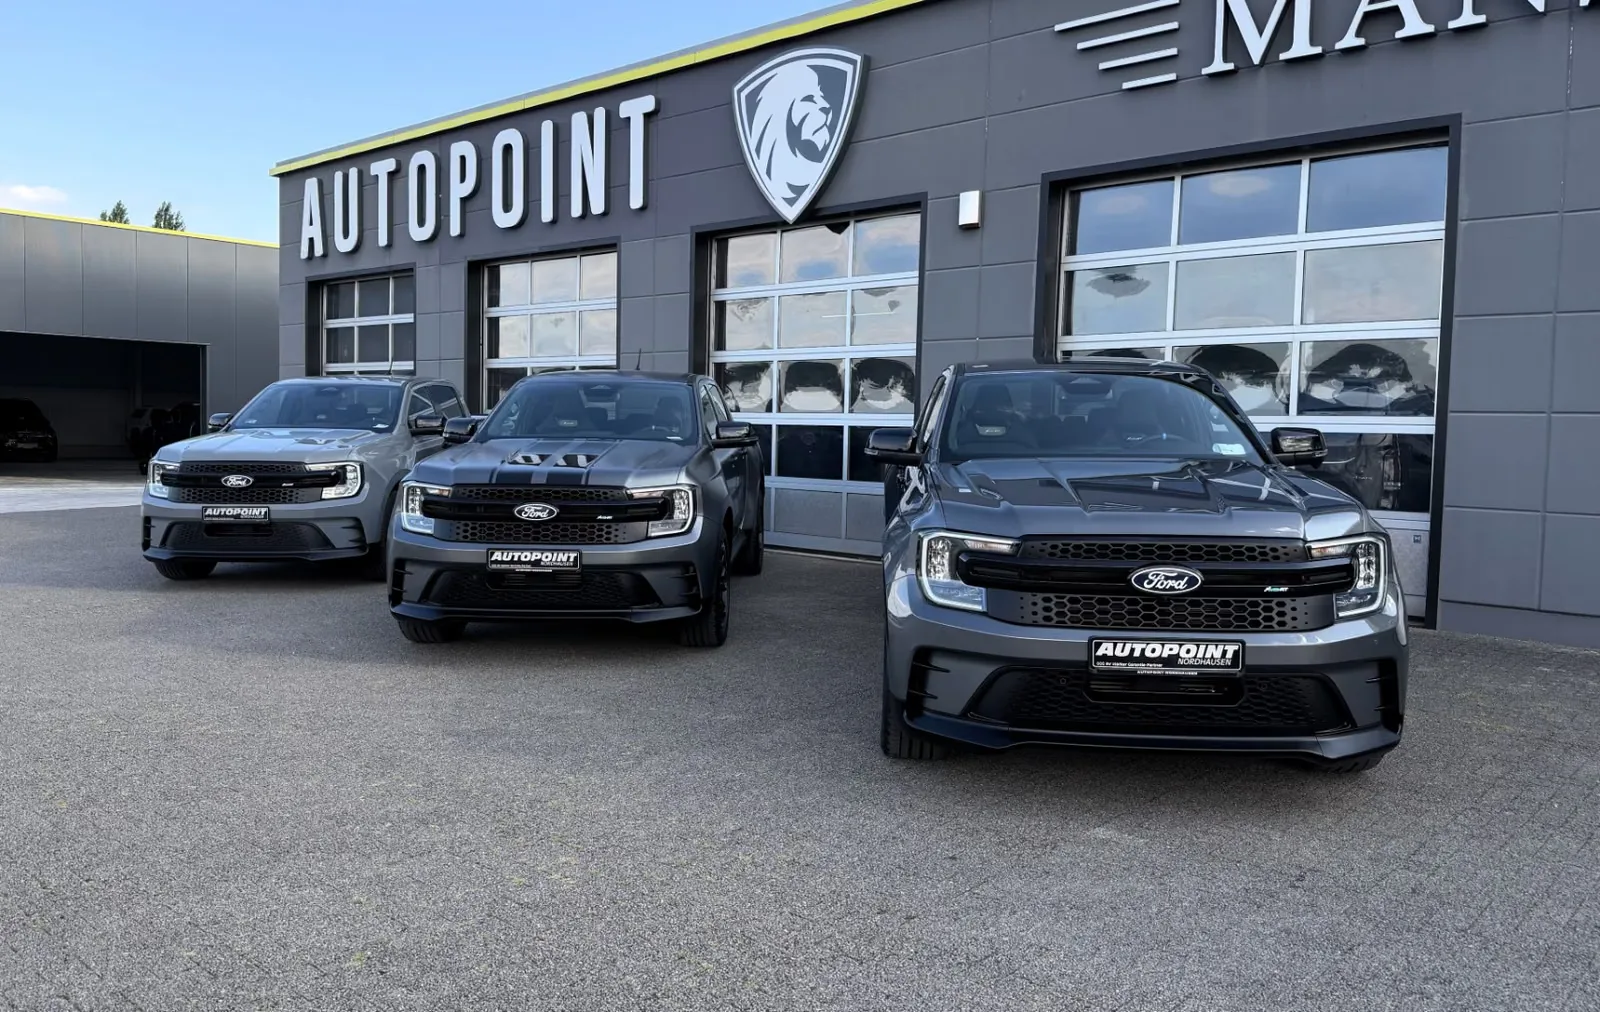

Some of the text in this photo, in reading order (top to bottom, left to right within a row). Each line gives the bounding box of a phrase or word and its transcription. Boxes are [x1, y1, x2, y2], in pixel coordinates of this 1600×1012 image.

[300, 94, 656, 259] AUTOPOINT
[521, 505, 549, 518] Ford
[491, 551, 577, 561] AUTOPOINT
[1143, 571, 1189, 590] Ford
[1095, 643, 1239, 658] AUTOPOINT
[1177, 658, 1232, 666] NORDHAUSEN
